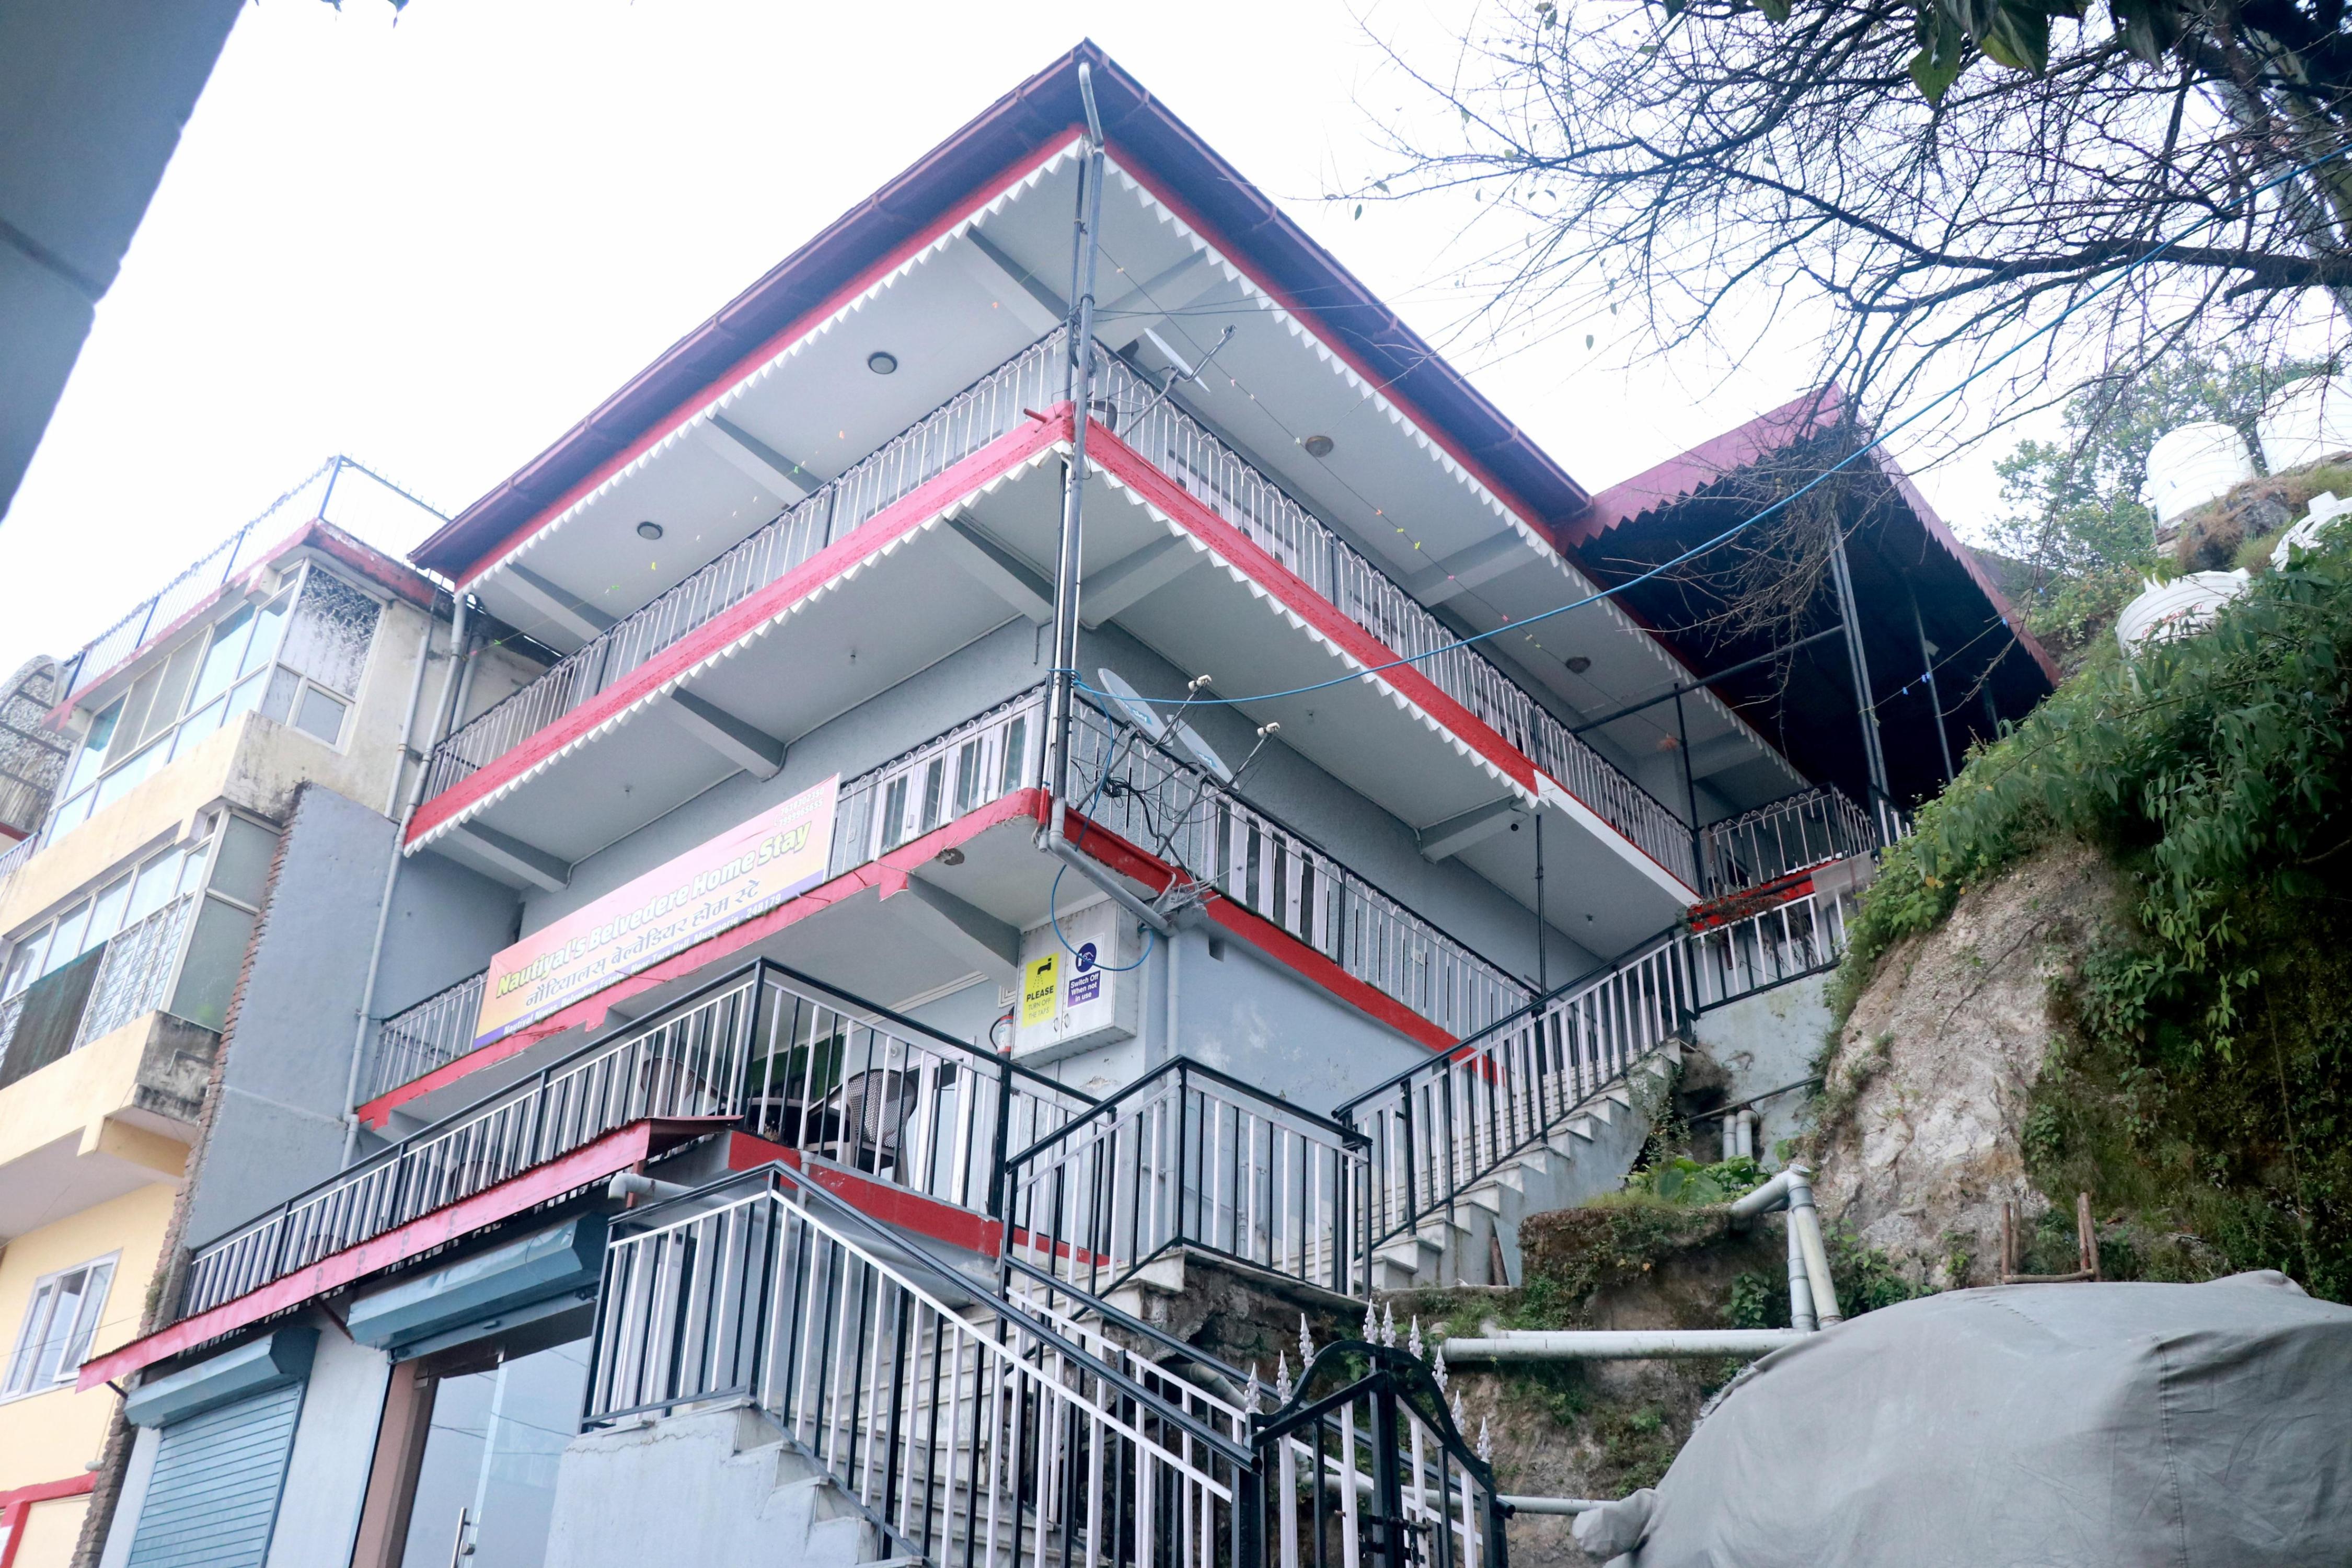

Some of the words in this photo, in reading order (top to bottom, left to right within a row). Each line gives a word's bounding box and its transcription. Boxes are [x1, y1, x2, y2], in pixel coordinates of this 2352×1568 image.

[495, 937, 587, 999] Nautiyal's
[587, 884, 690, 952] Belvedere
[691, 850, 756, 900] Home
[757, 821, 812, 867] Stay
[691, 896, 731, 927] होम
[734, 879, 760, 904] स्टे
[746, 893, 781, 916] 248179
[1070, 976, 1089, 988] Switch
[1090, 972, 1099, 982] Off
[1026, 985, 1054, 1002] PLEASE
[1071, 986, 1087, 996] When
[1088, 981, 1097, 990] not
[1082, 991, 1092, 1000] use
[1029, 1001, 1041, 1011] TURN
[1041, 997, 1051, 1006] OFF
[1038, 1007, 1050, 1017] TAPS
